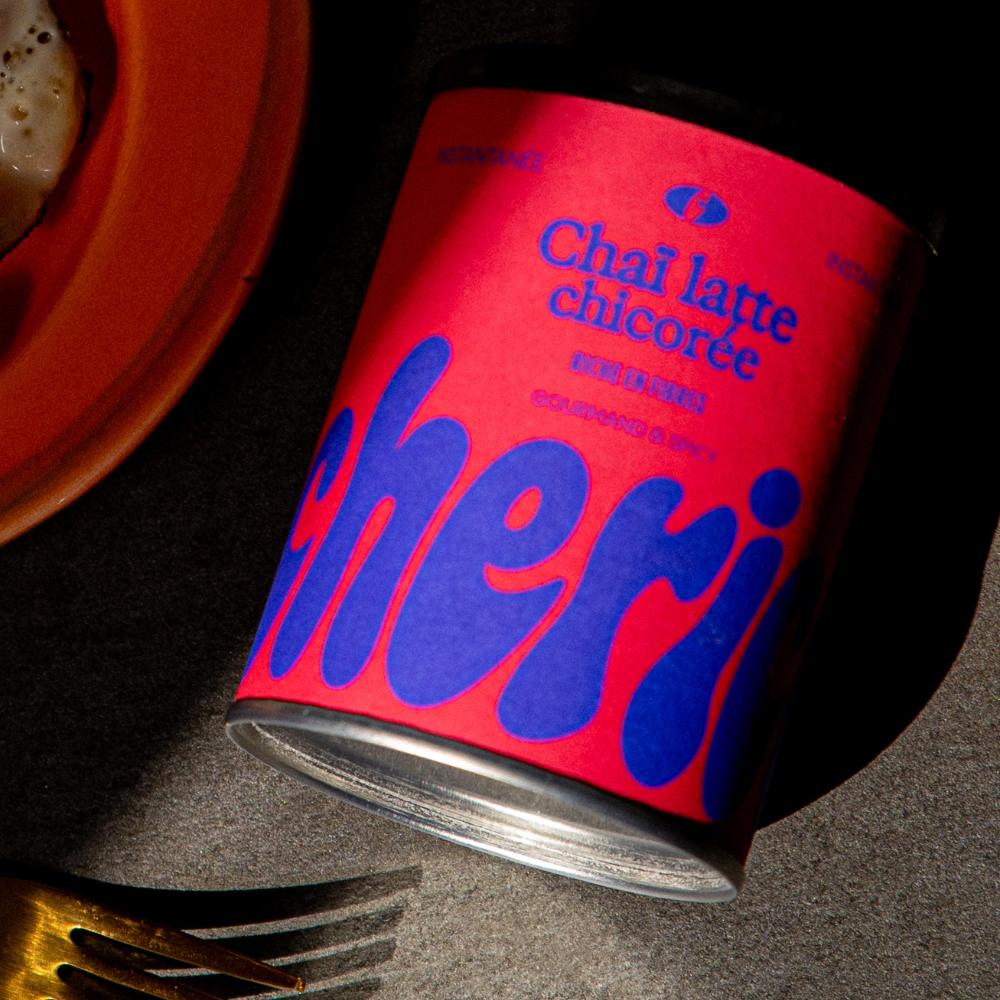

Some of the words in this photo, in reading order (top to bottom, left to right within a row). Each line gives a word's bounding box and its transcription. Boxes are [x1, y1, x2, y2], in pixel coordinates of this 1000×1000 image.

[538, 218, 678, 296] Chaï
[678, 254, 798, 345] latte
[825, 251, 886, 299] INSTAN
[547, 279, 761, 382] chicorée
[569, 350, 623, 385] RICHE
[622, 367, 649, 393] EN
[648, 376, 708, 415] FIBRES
[530, 389, 647, 438] GOURMAND
[648, 427, 665, 445] &
[669, 433, 719, 464] SPICY
